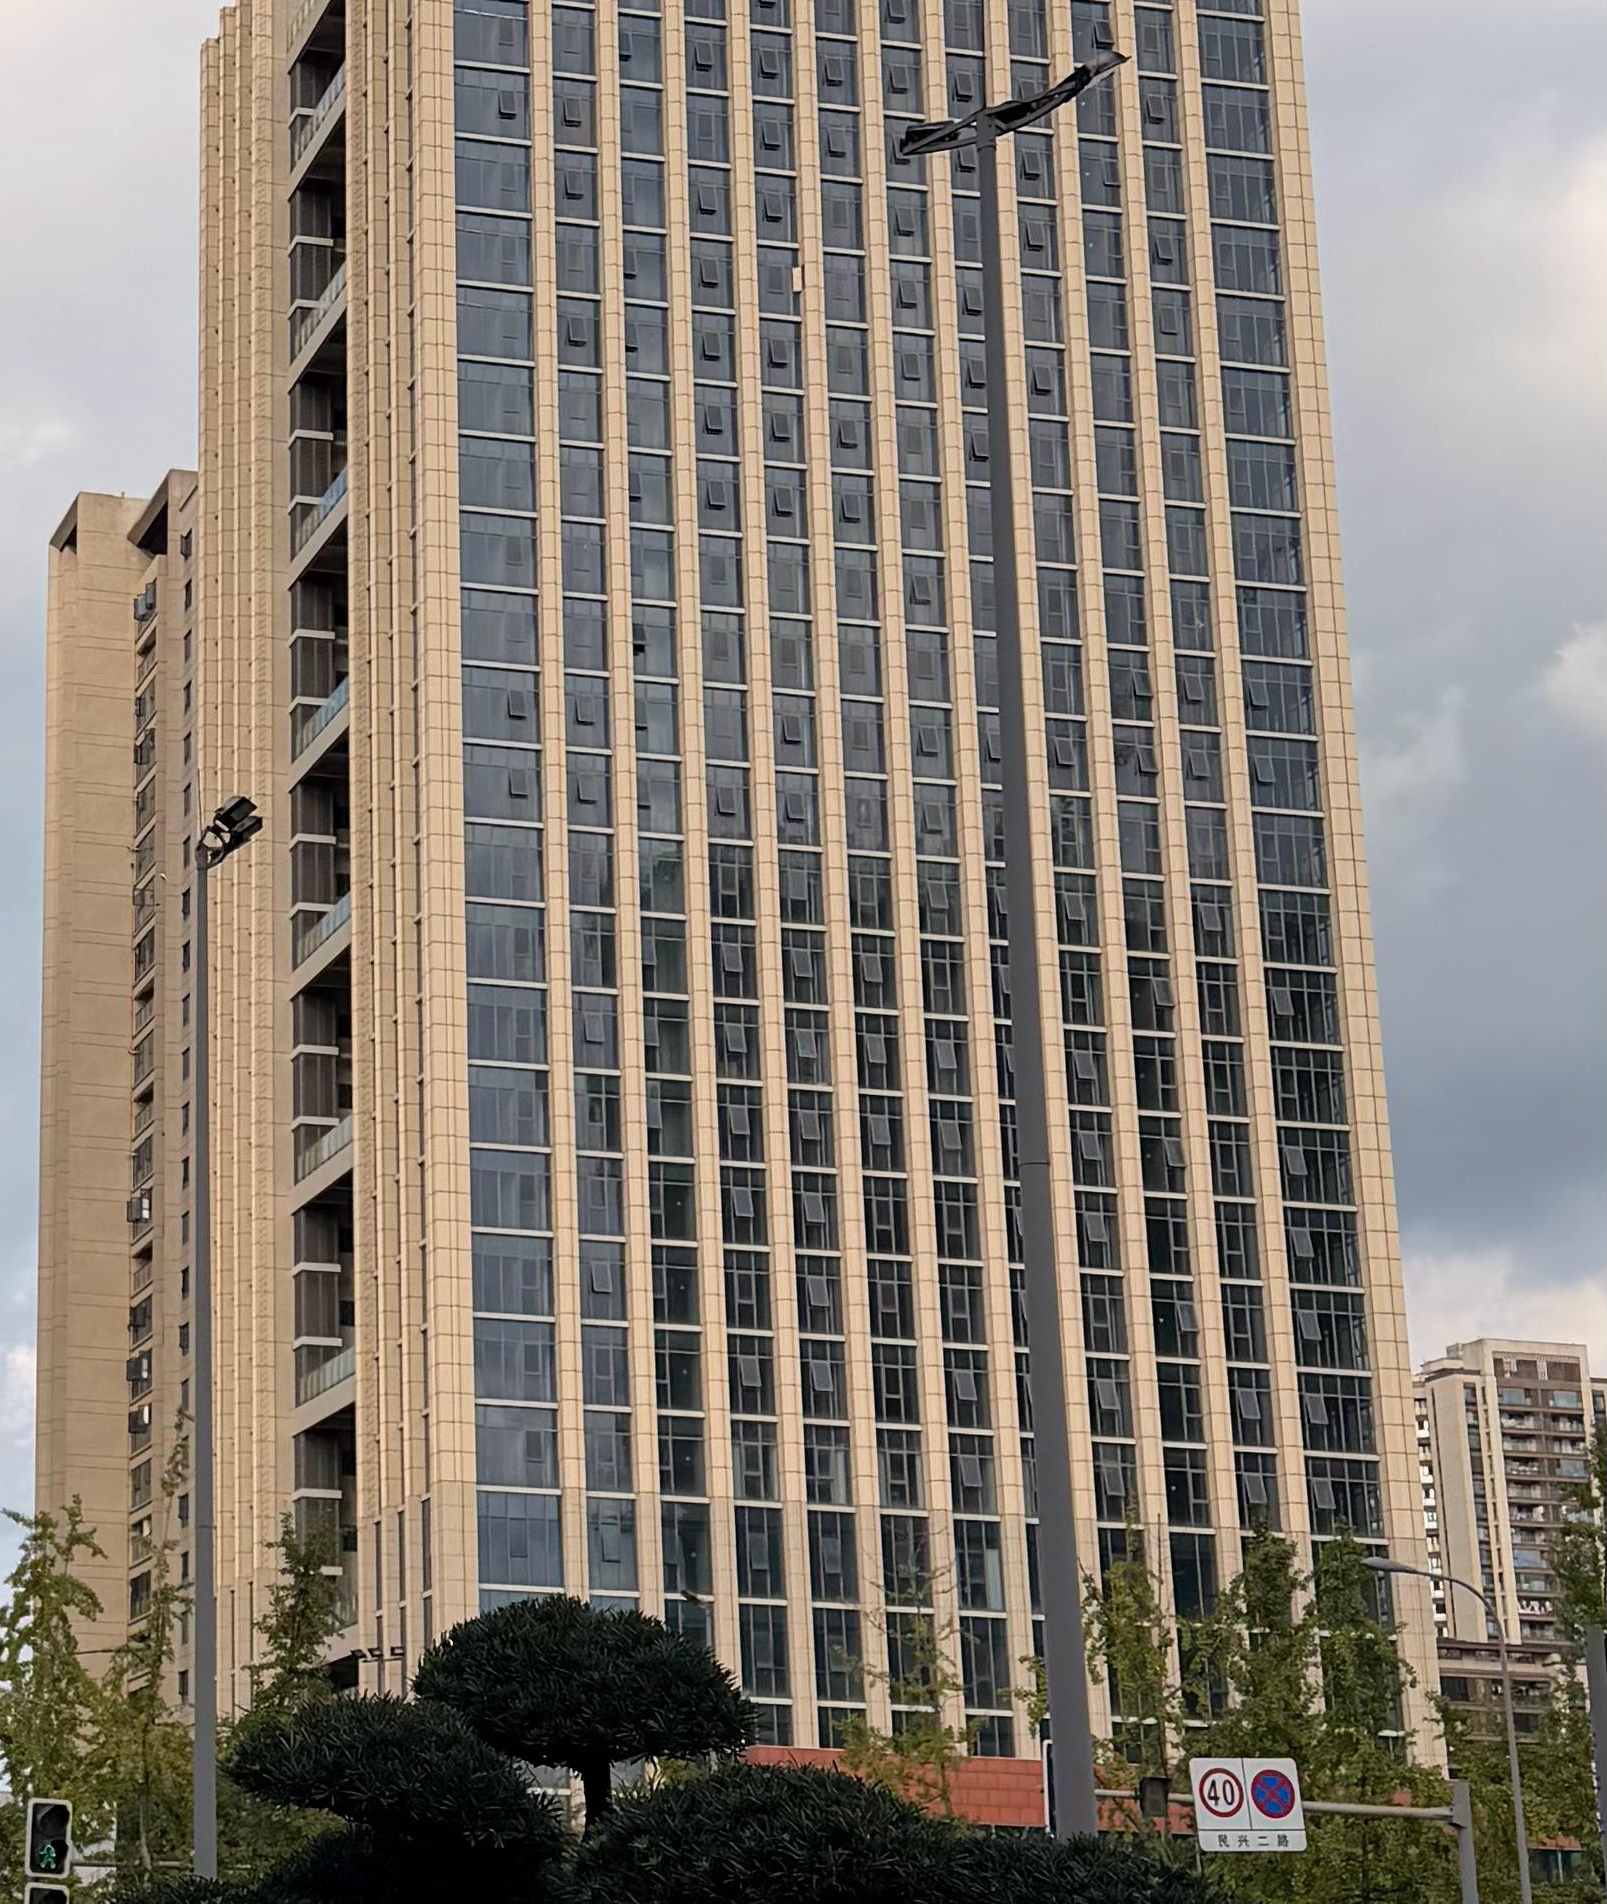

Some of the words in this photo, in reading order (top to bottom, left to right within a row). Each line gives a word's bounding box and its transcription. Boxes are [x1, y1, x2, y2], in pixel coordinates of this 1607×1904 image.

[1207, 1779, 1235, 1806] 40
[1217, 1834, 1289, 1848] 民兴二路
